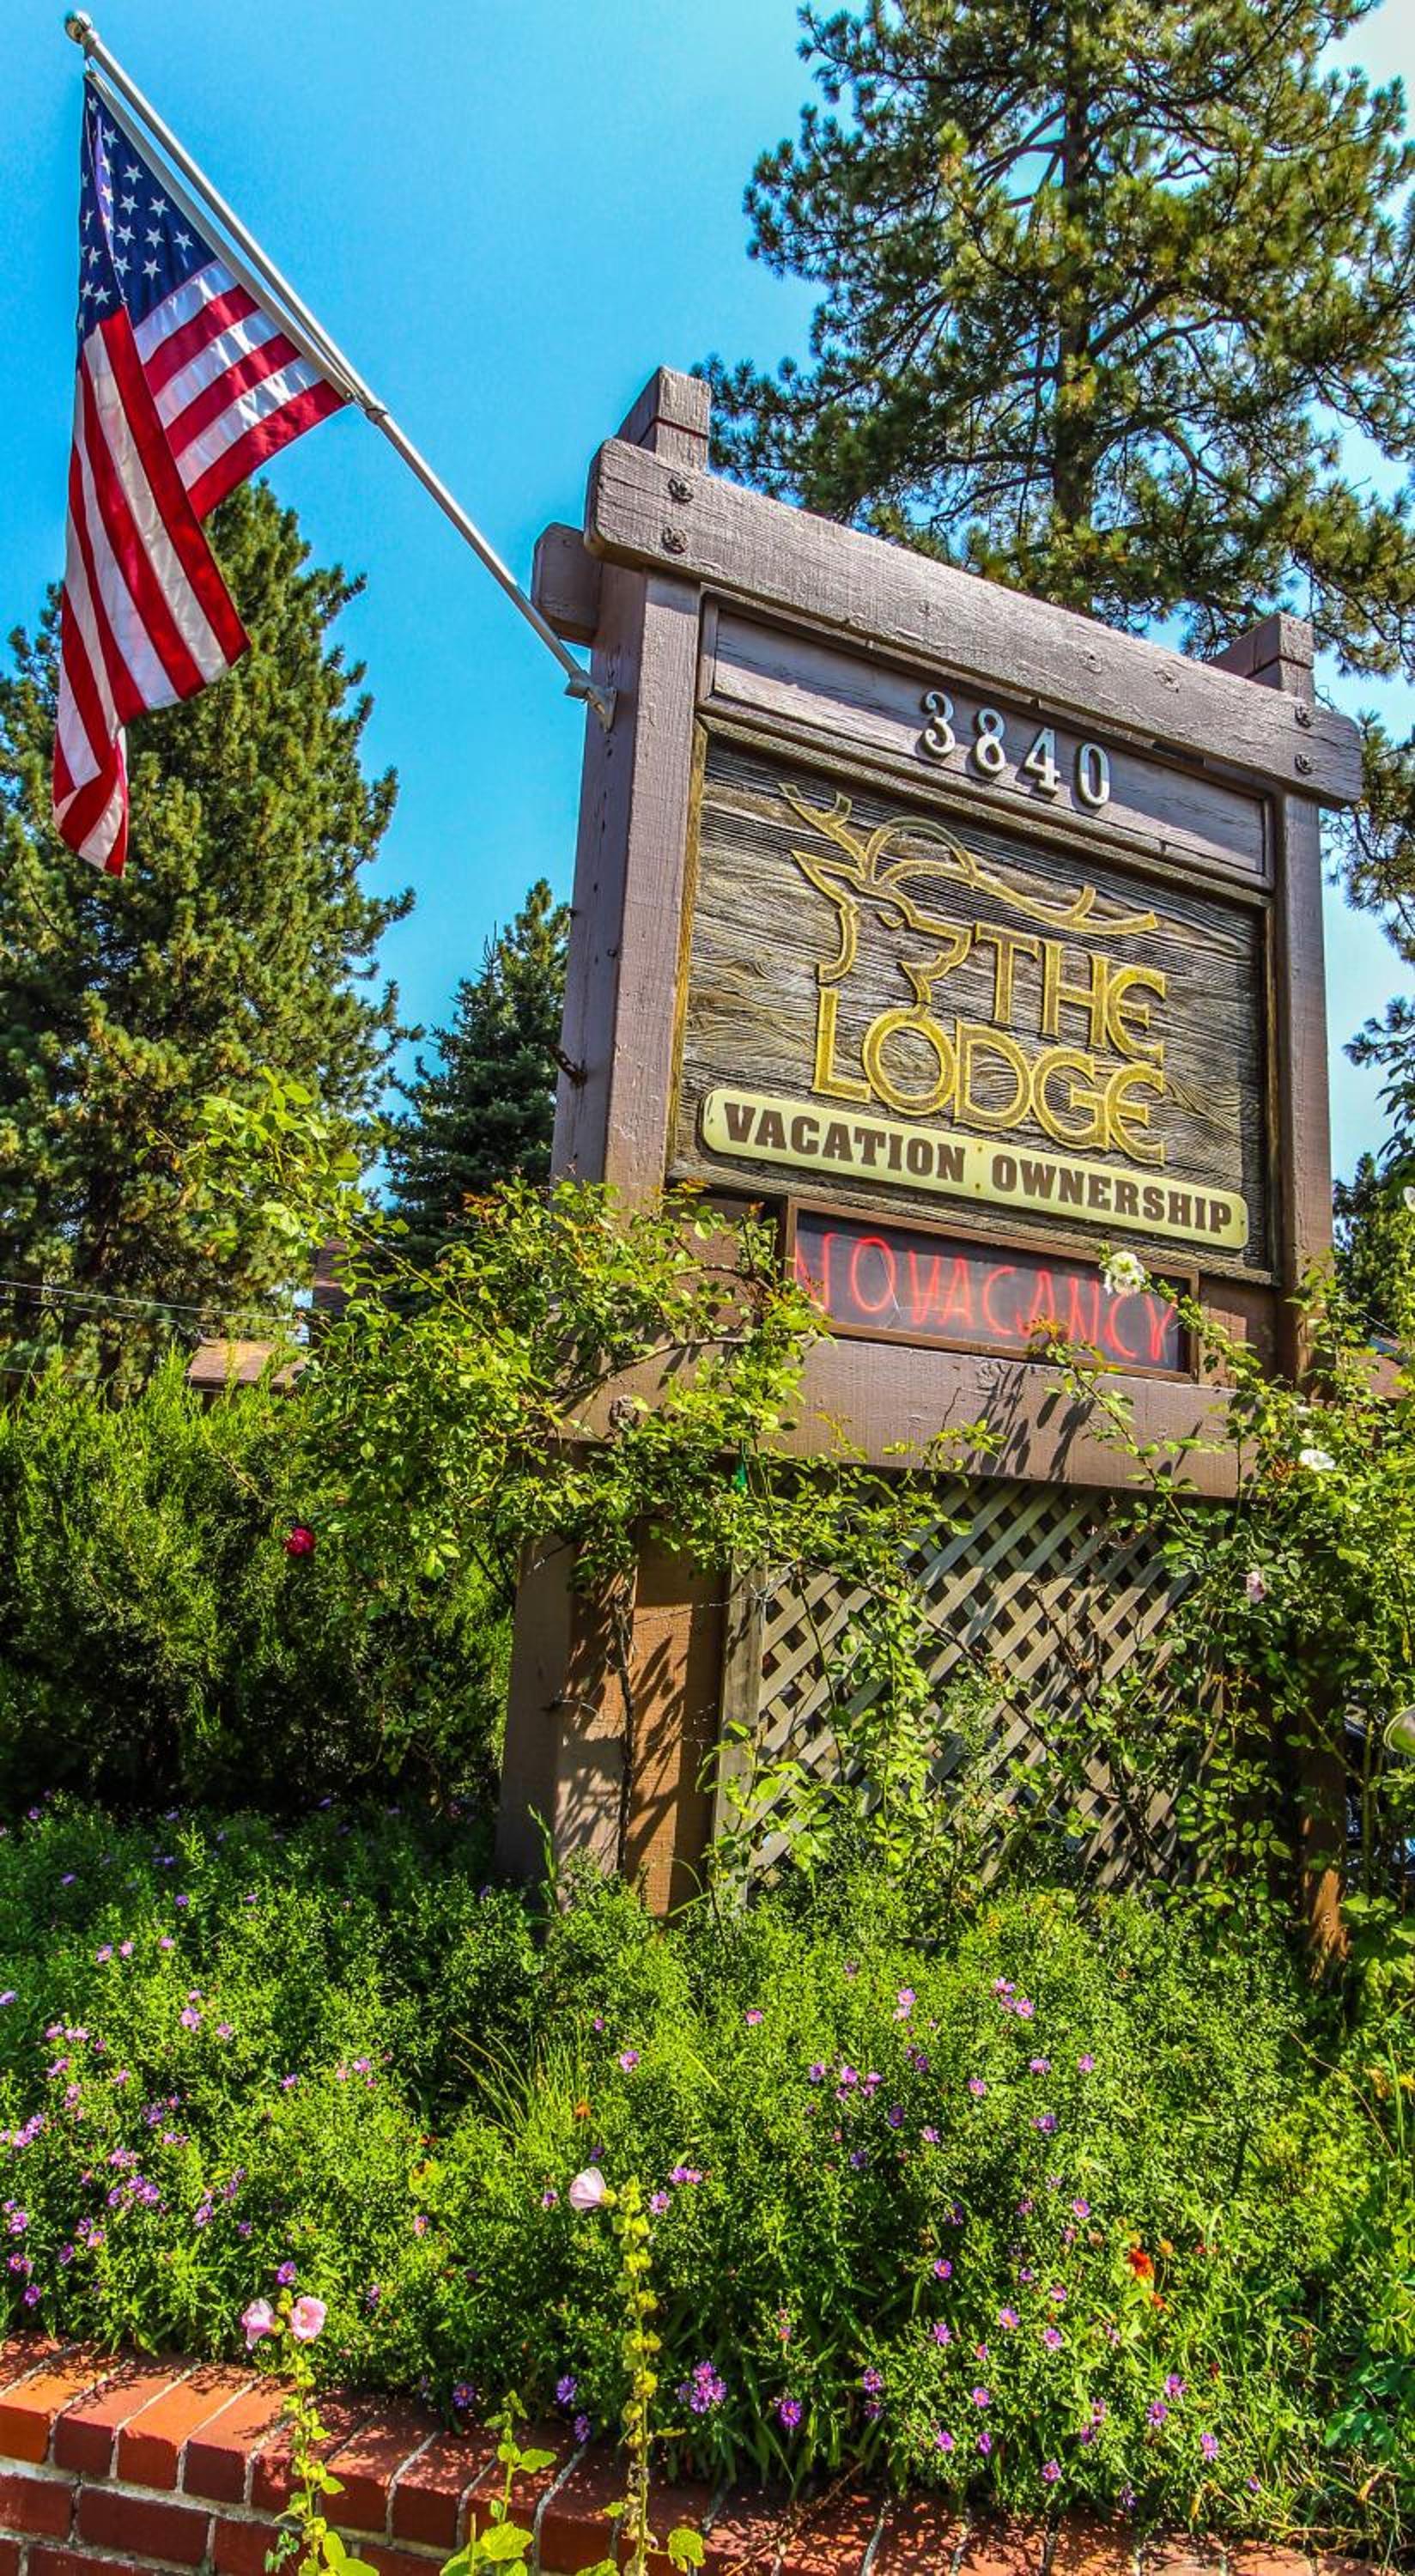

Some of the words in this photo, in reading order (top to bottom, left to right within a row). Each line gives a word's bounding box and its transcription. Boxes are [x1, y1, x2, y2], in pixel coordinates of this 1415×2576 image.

[920, 690, 1111, 808] 3840
[974, 921, 1166, 1065] THE
[812, 987, 1166, 1166] LODGE
[723, 1103, 966, 1182] VACATION
[991, 1155, 1232, 1234] OWNERSHIP
